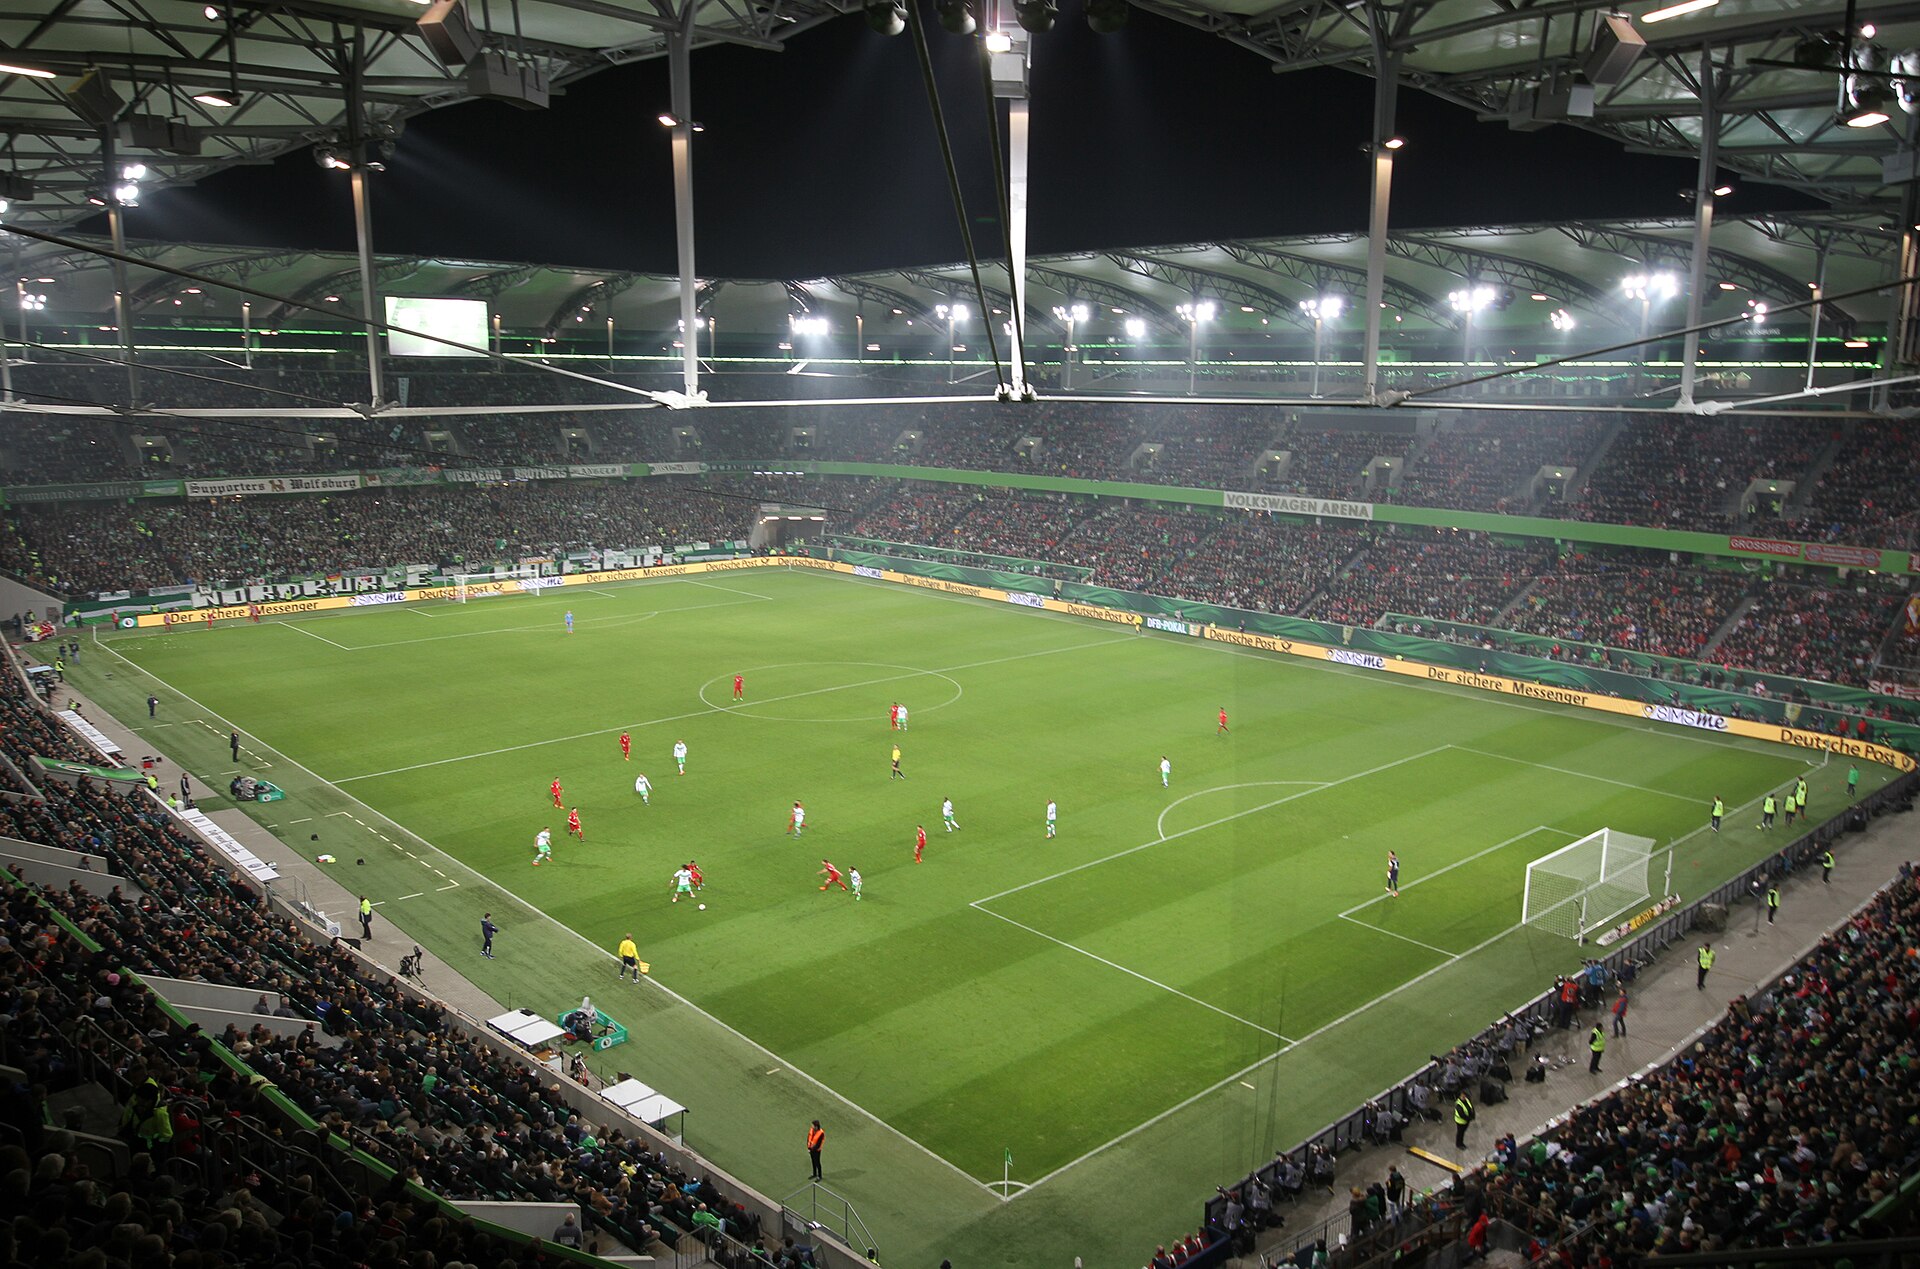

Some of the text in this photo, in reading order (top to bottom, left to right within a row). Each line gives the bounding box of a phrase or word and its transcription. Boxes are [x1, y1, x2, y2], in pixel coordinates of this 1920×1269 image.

[189, 478, 357, 495] Supporters Wolfsburg
[1226, 494, 1370, 518] VOLKSWAGEN ARENA
[171, 612, 193, 624] Der
[1067, 603, 1122, 624] Deutsche Post
[1209, 628, 1277, 651] Deutsche Post
[1428, 667, 1589, 706] Der sichere Messenger
[1780, 728, 1896, 766] Deutsche Post
